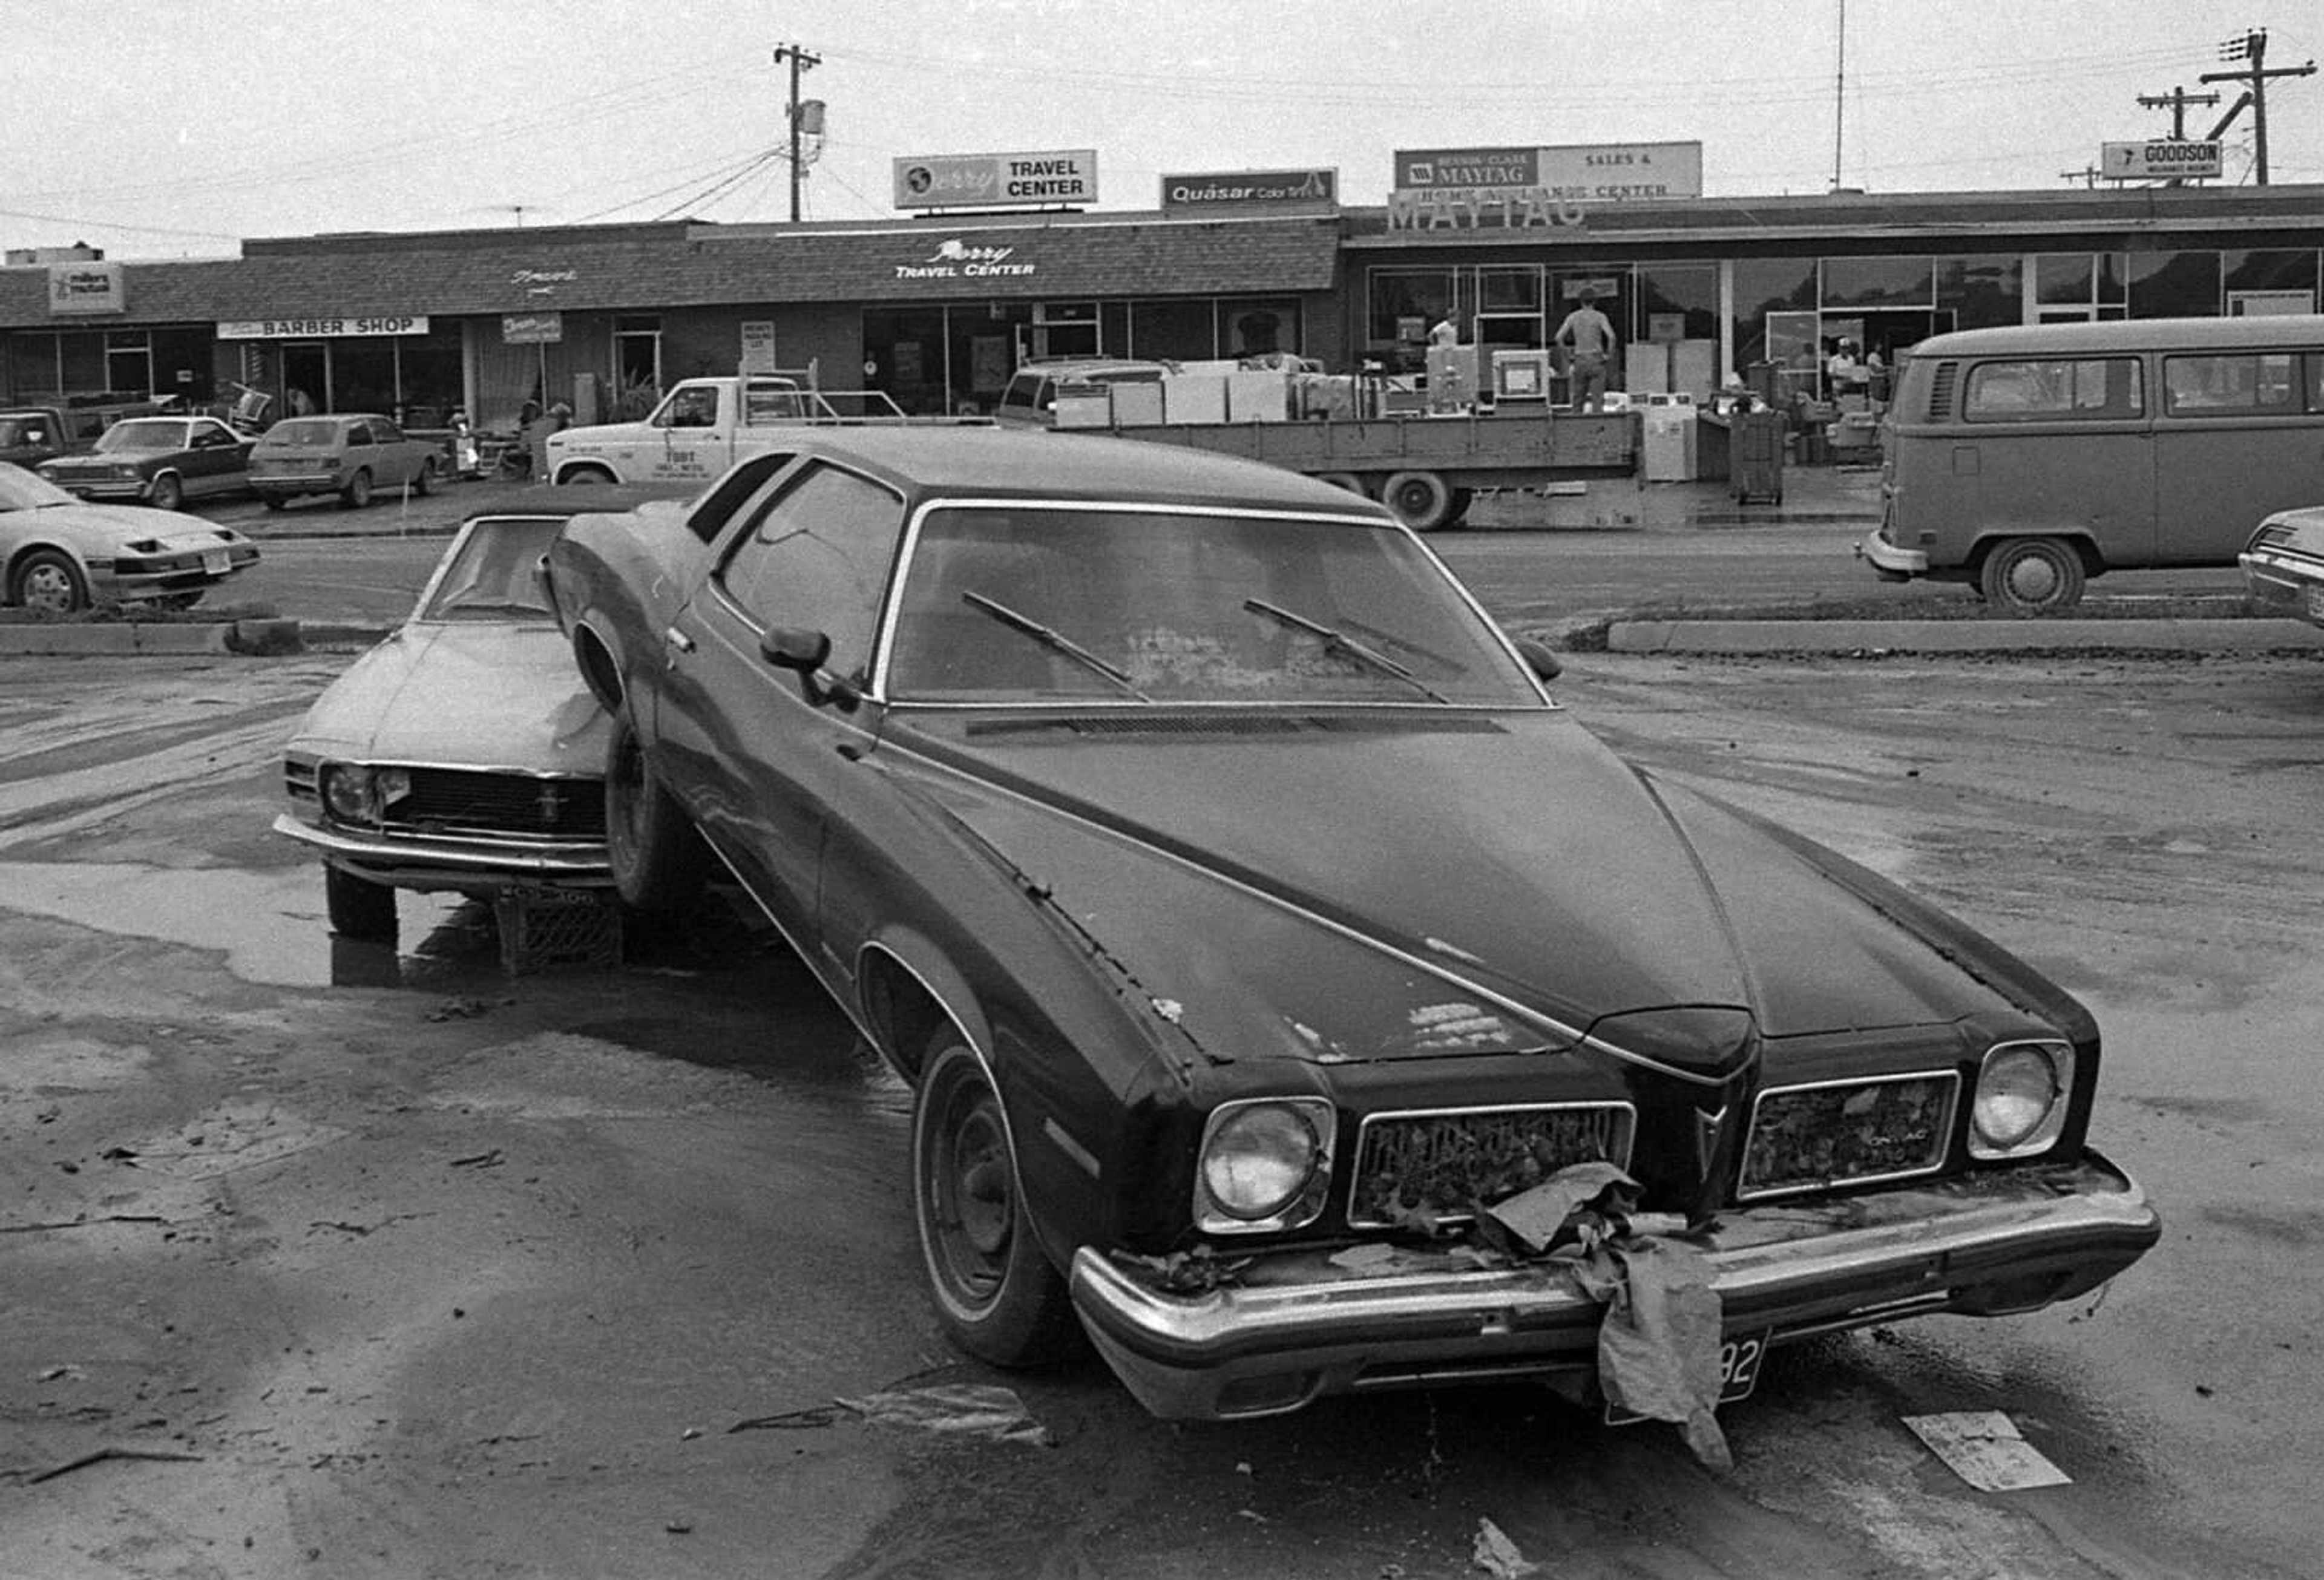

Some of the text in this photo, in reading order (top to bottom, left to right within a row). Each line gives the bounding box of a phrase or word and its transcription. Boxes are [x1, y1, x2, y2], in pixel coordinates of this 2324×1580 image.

[2145, 145, 2217, 162] GOODSON
[1010, 160, 1079, 176] TRAVEL
[1439, 166, 1523, 184] MAYTAG
[1008, 179, 1083, 197] CENTER
[1388, 190, 1584, 231] MAYTAG
[896, 264, 1036, 278] TRAVEL CENTER
[263, 321, 344, 335] BARBER
[357, 318, 413, 333] SHOP
